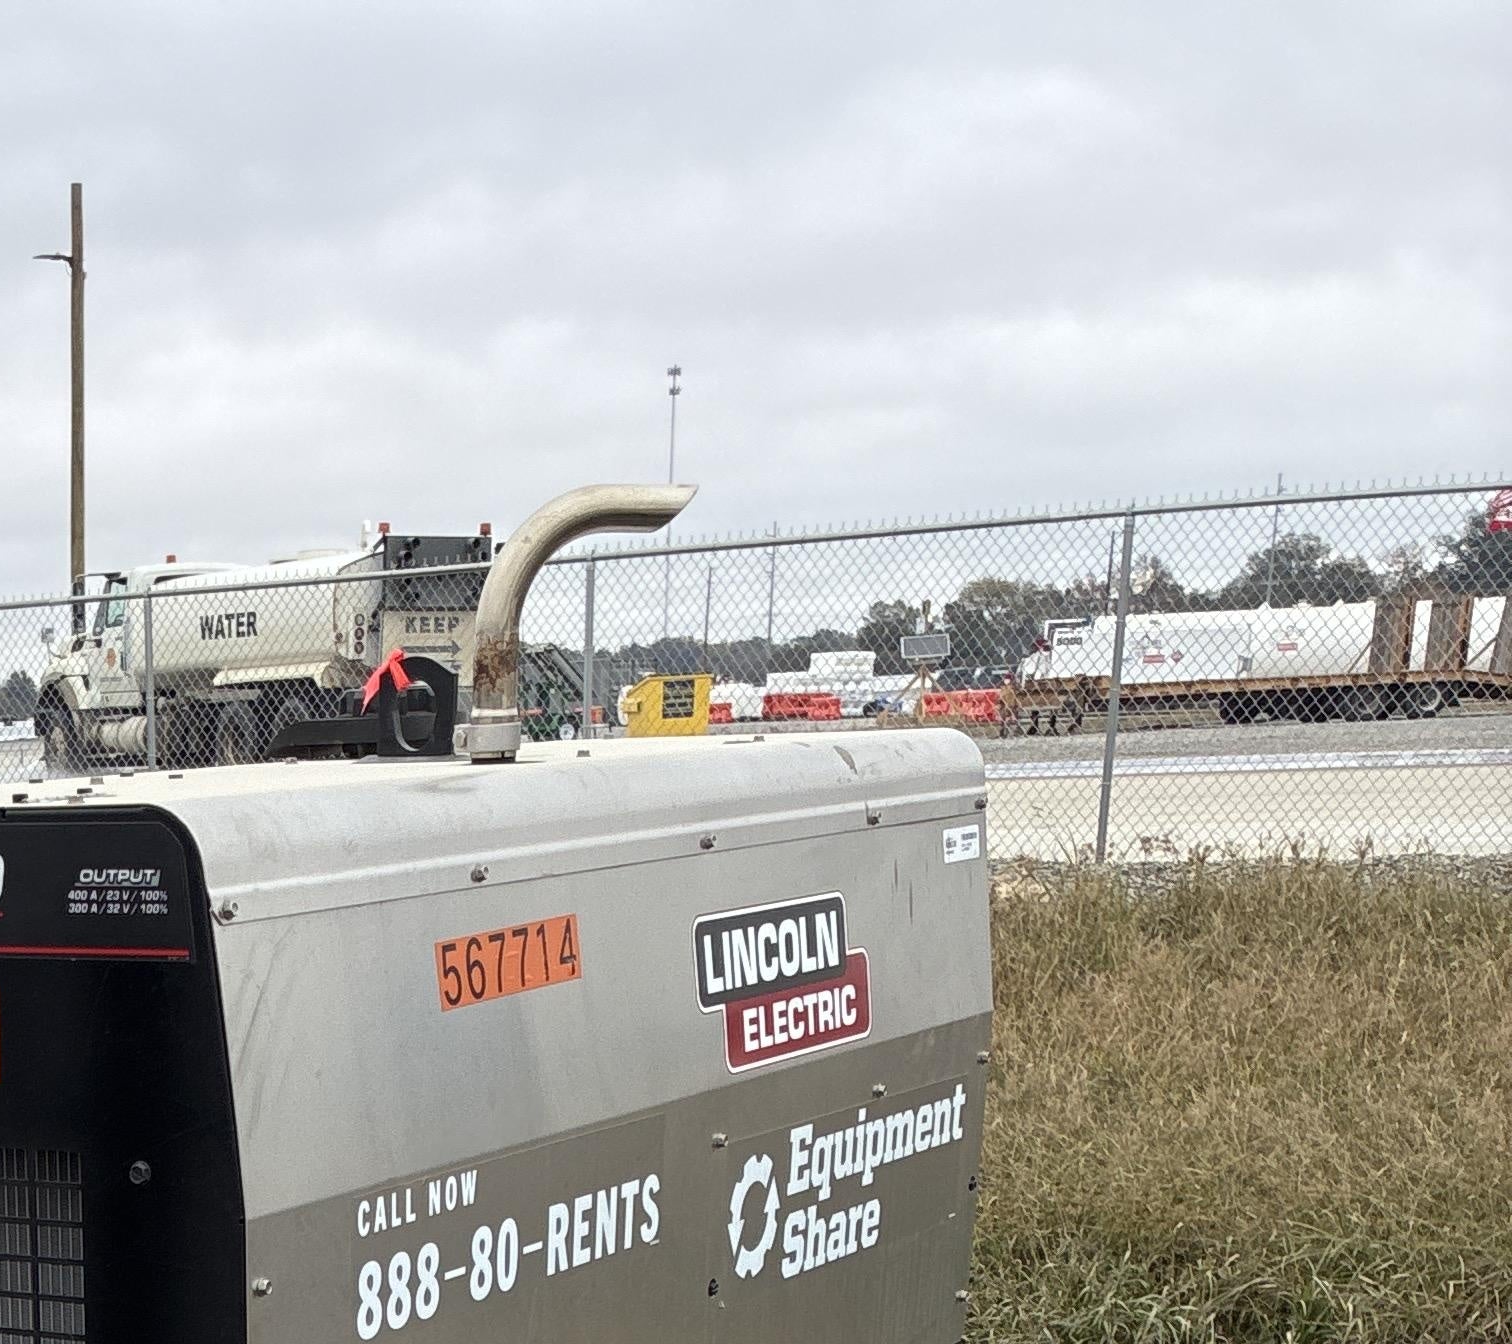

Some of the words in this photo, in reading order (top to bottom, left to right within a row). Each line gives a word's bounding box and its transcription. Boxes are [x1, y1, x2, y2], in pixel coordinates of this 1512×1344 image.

[199, 611, 258, 640] WATER
[405, 616, 460, 634] KEEP
[68, 890, 88, 901] 400
[140, 890, 168, 902] 100%
[79, 868, 156, 883] OUTPUT
[140, 903, 168, 915] 100%
[441, 917, 577, 1006] 567714
[703, 910, 840, 995] LINCOLN
[742, 984, 857, 1053] ELECTRIC
[787, 1083, 967, 1202] Equipment
[357, 1188, 417, 1237] CALL
[428, 1169, 478, 1217] NOW
[356, 1173, 661, 1341] 888-80-RENTS
[781, 1198, 882, 1280] Share
